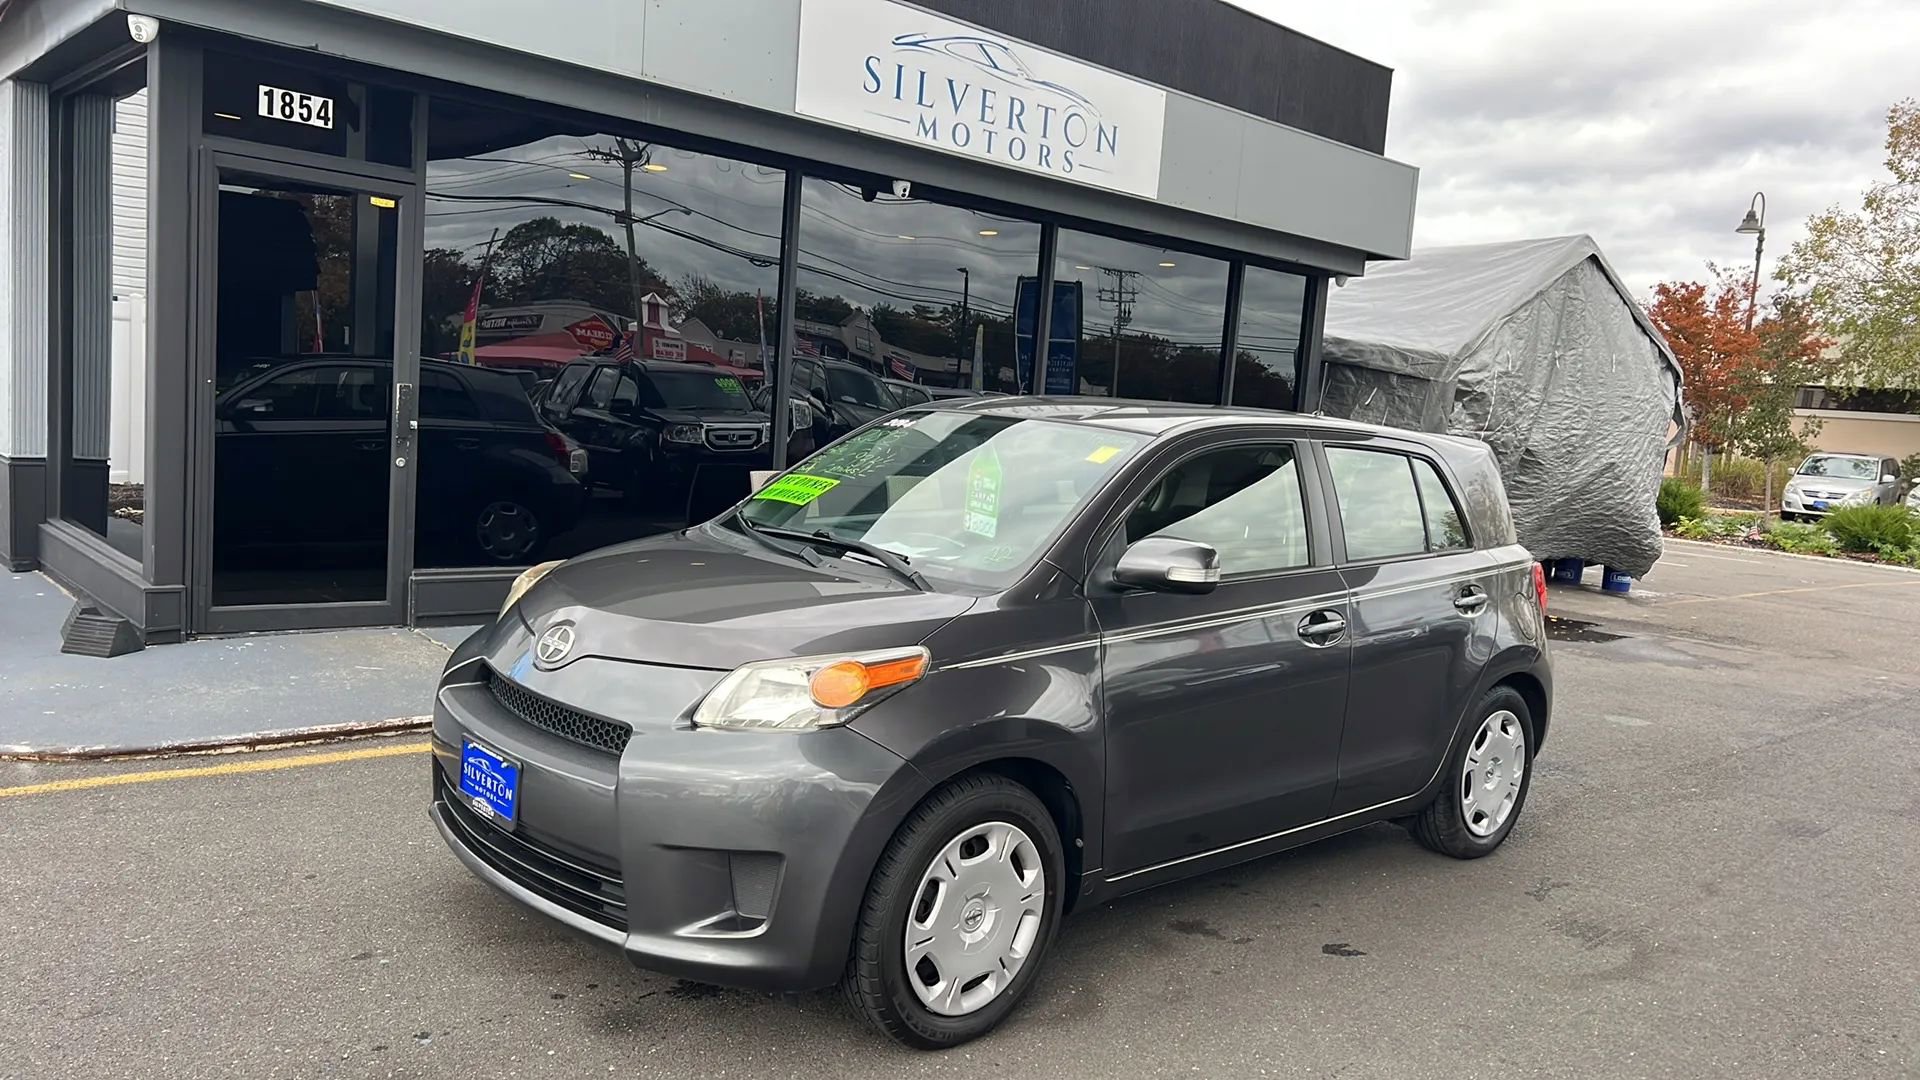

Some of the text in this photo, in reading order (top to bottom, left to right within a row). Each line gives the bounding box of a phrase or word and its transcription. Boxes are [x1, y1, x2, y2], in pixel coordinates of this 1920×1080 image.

[263, 88, 332, 127] 1854
[863, 55, 1118, 157] SILVERTON
[916, 114, 1074, 174] MOTORS
[463, 762, 512, 801] SILVERTON
[474, 784, 497, 802] MOTORS
